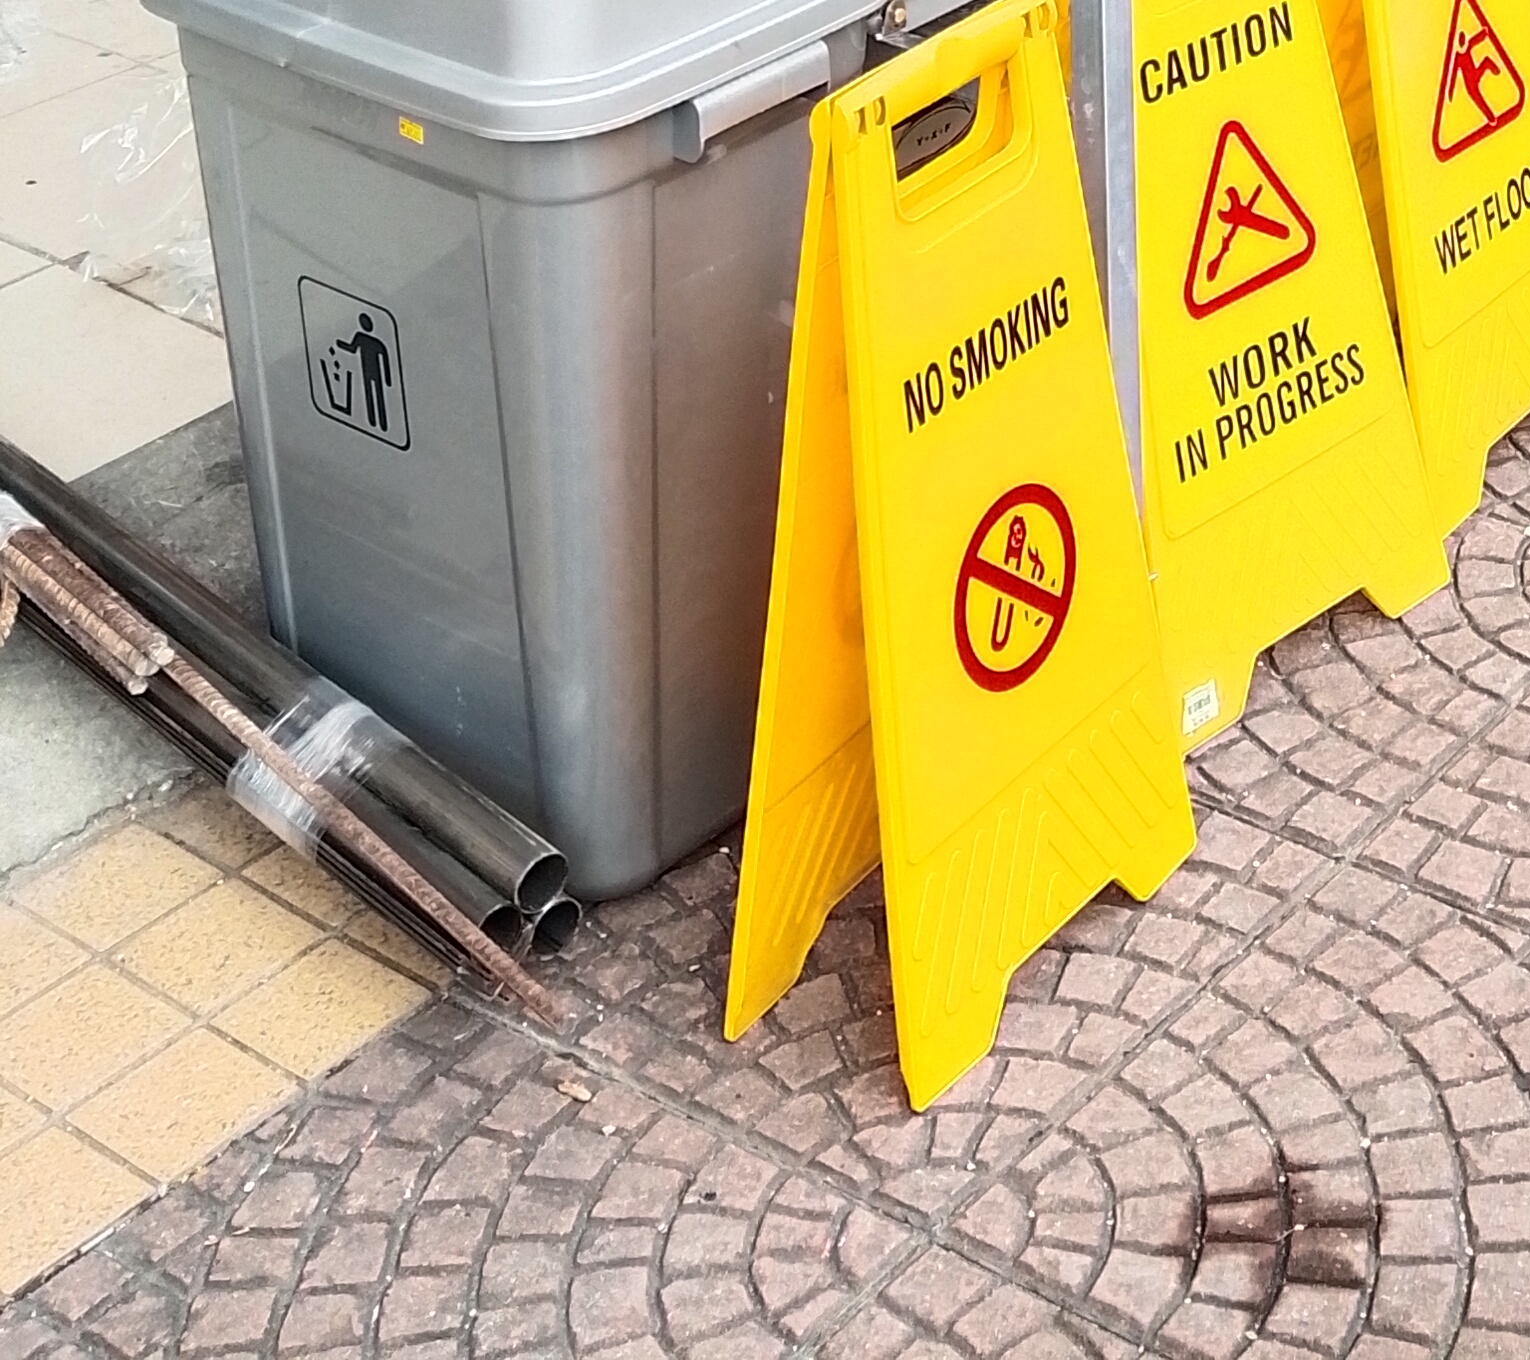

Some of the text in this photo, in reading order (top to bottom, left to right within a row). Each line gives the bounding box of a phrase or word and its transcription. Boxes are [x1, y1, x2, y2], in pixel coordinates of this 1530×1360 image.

[1140, 0, 1293, 104] CAUTION
[1434, 206, 1480, 276] WET
[903, 276, 1069, 434] NO SMOKING
[1208, 316, 1317, 407] WORK
[1174, 343, 1365, 484] IN PROGRESS
